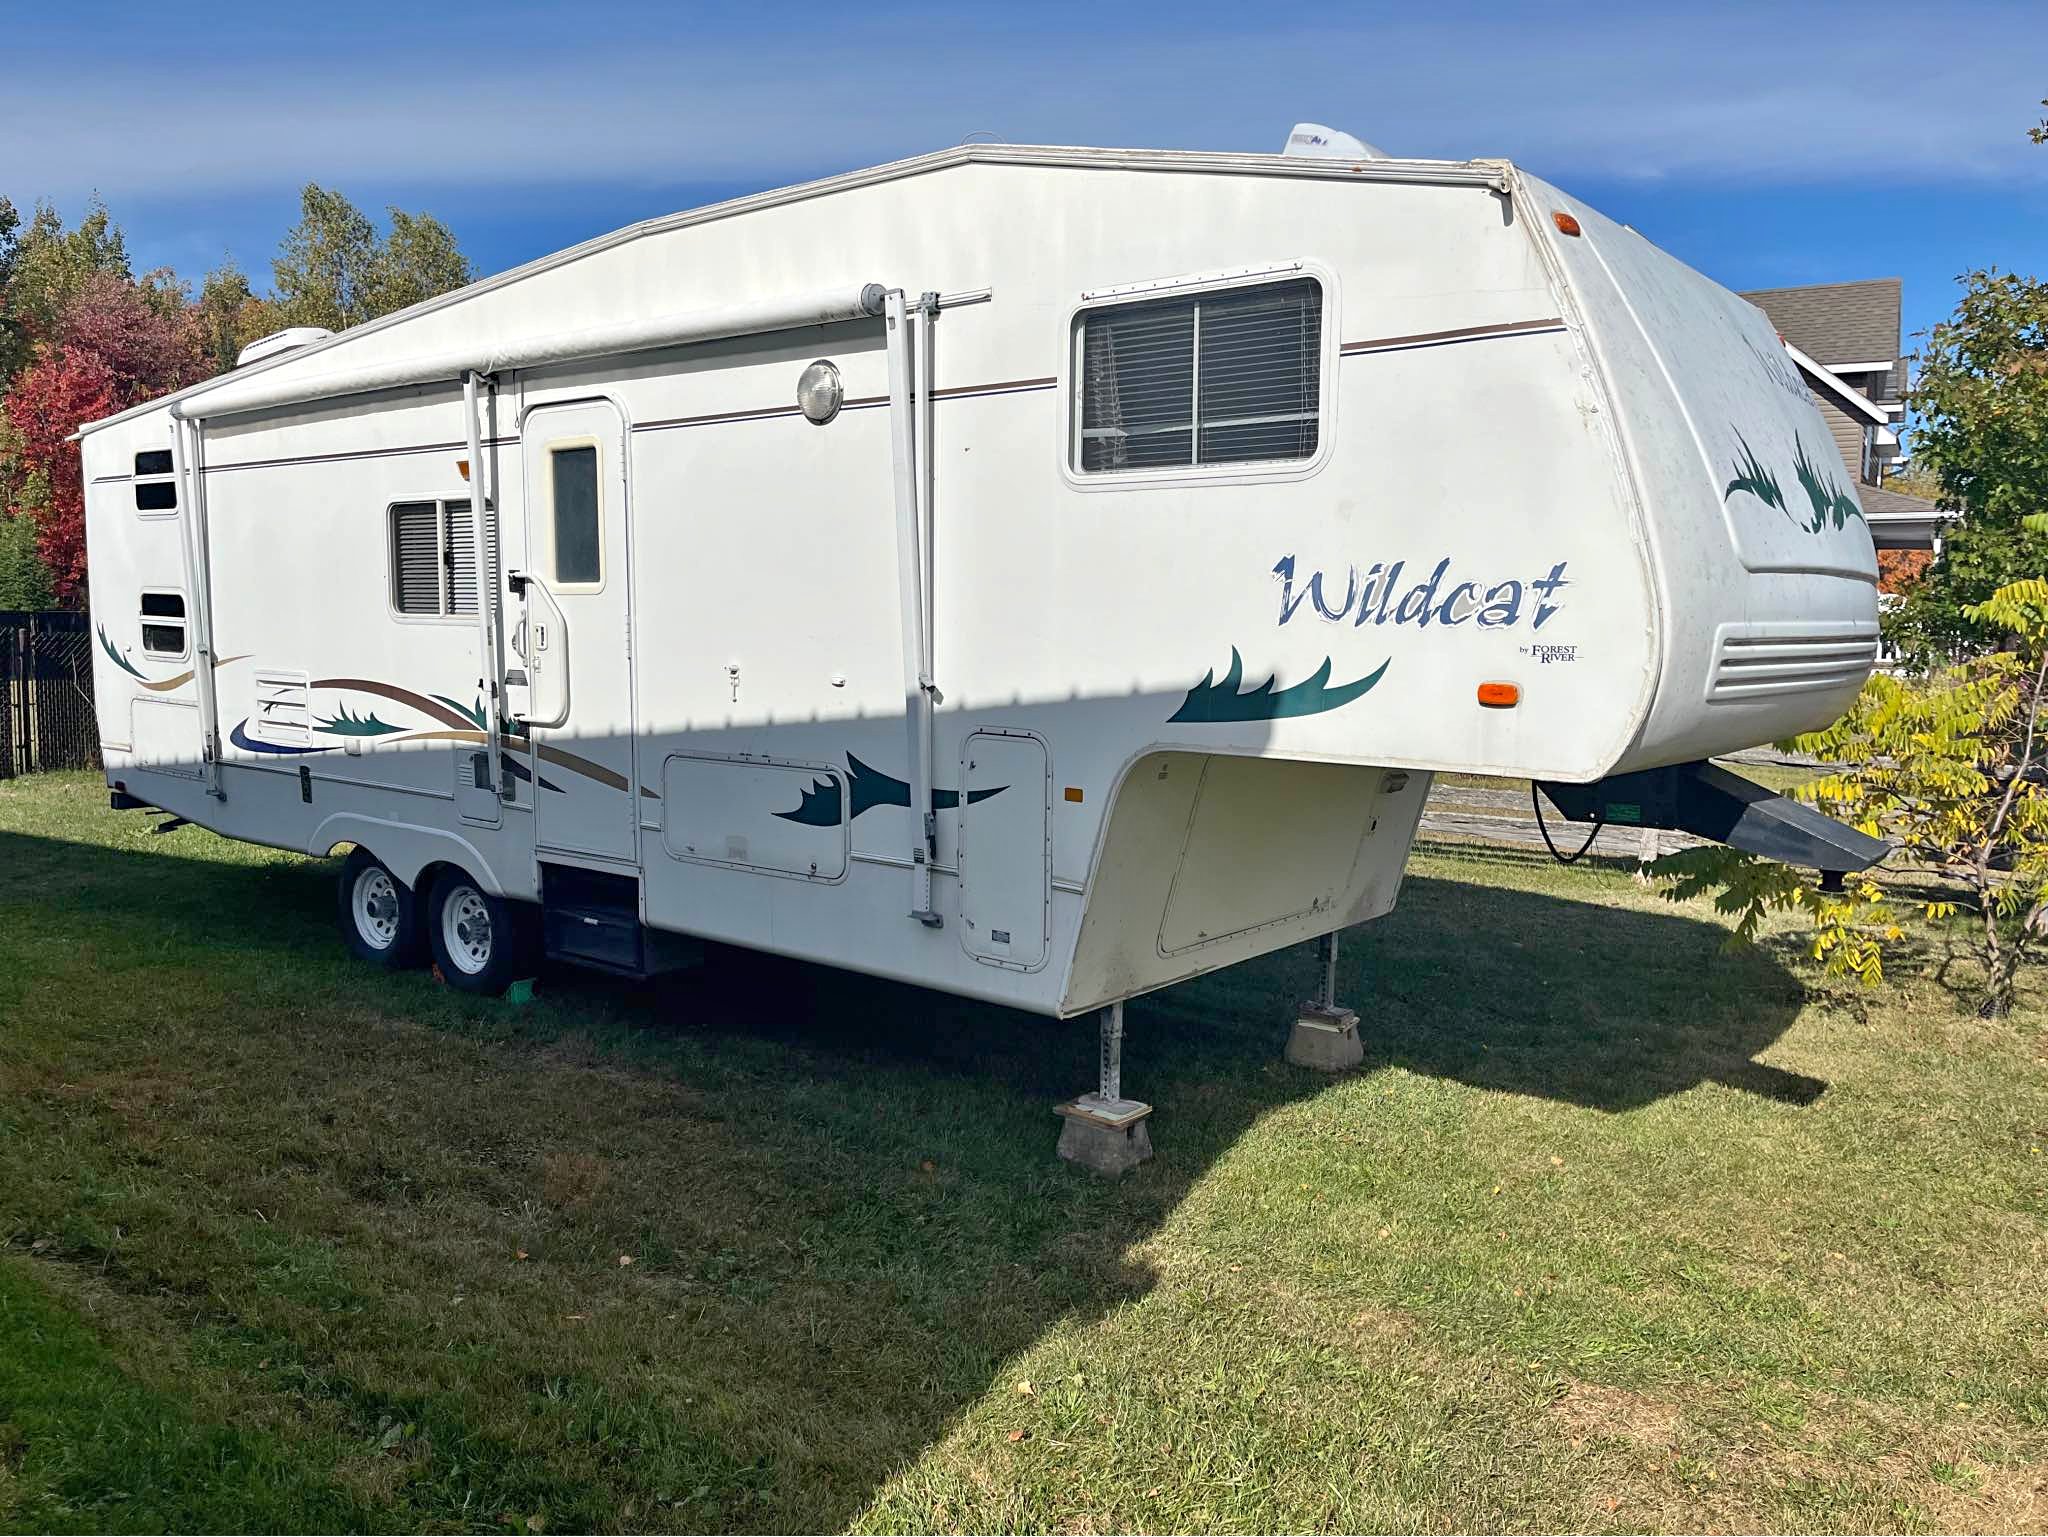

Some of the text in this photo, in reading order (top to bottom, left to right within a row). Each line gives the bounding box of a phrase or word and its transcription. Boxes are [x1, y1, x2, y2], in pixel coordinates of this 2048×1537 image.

[1271, 554, 1571, 630] Wildcat
[1519, 645, 1578, 656] by FOREST
[1541, 653, 1576, 664] RIVER
